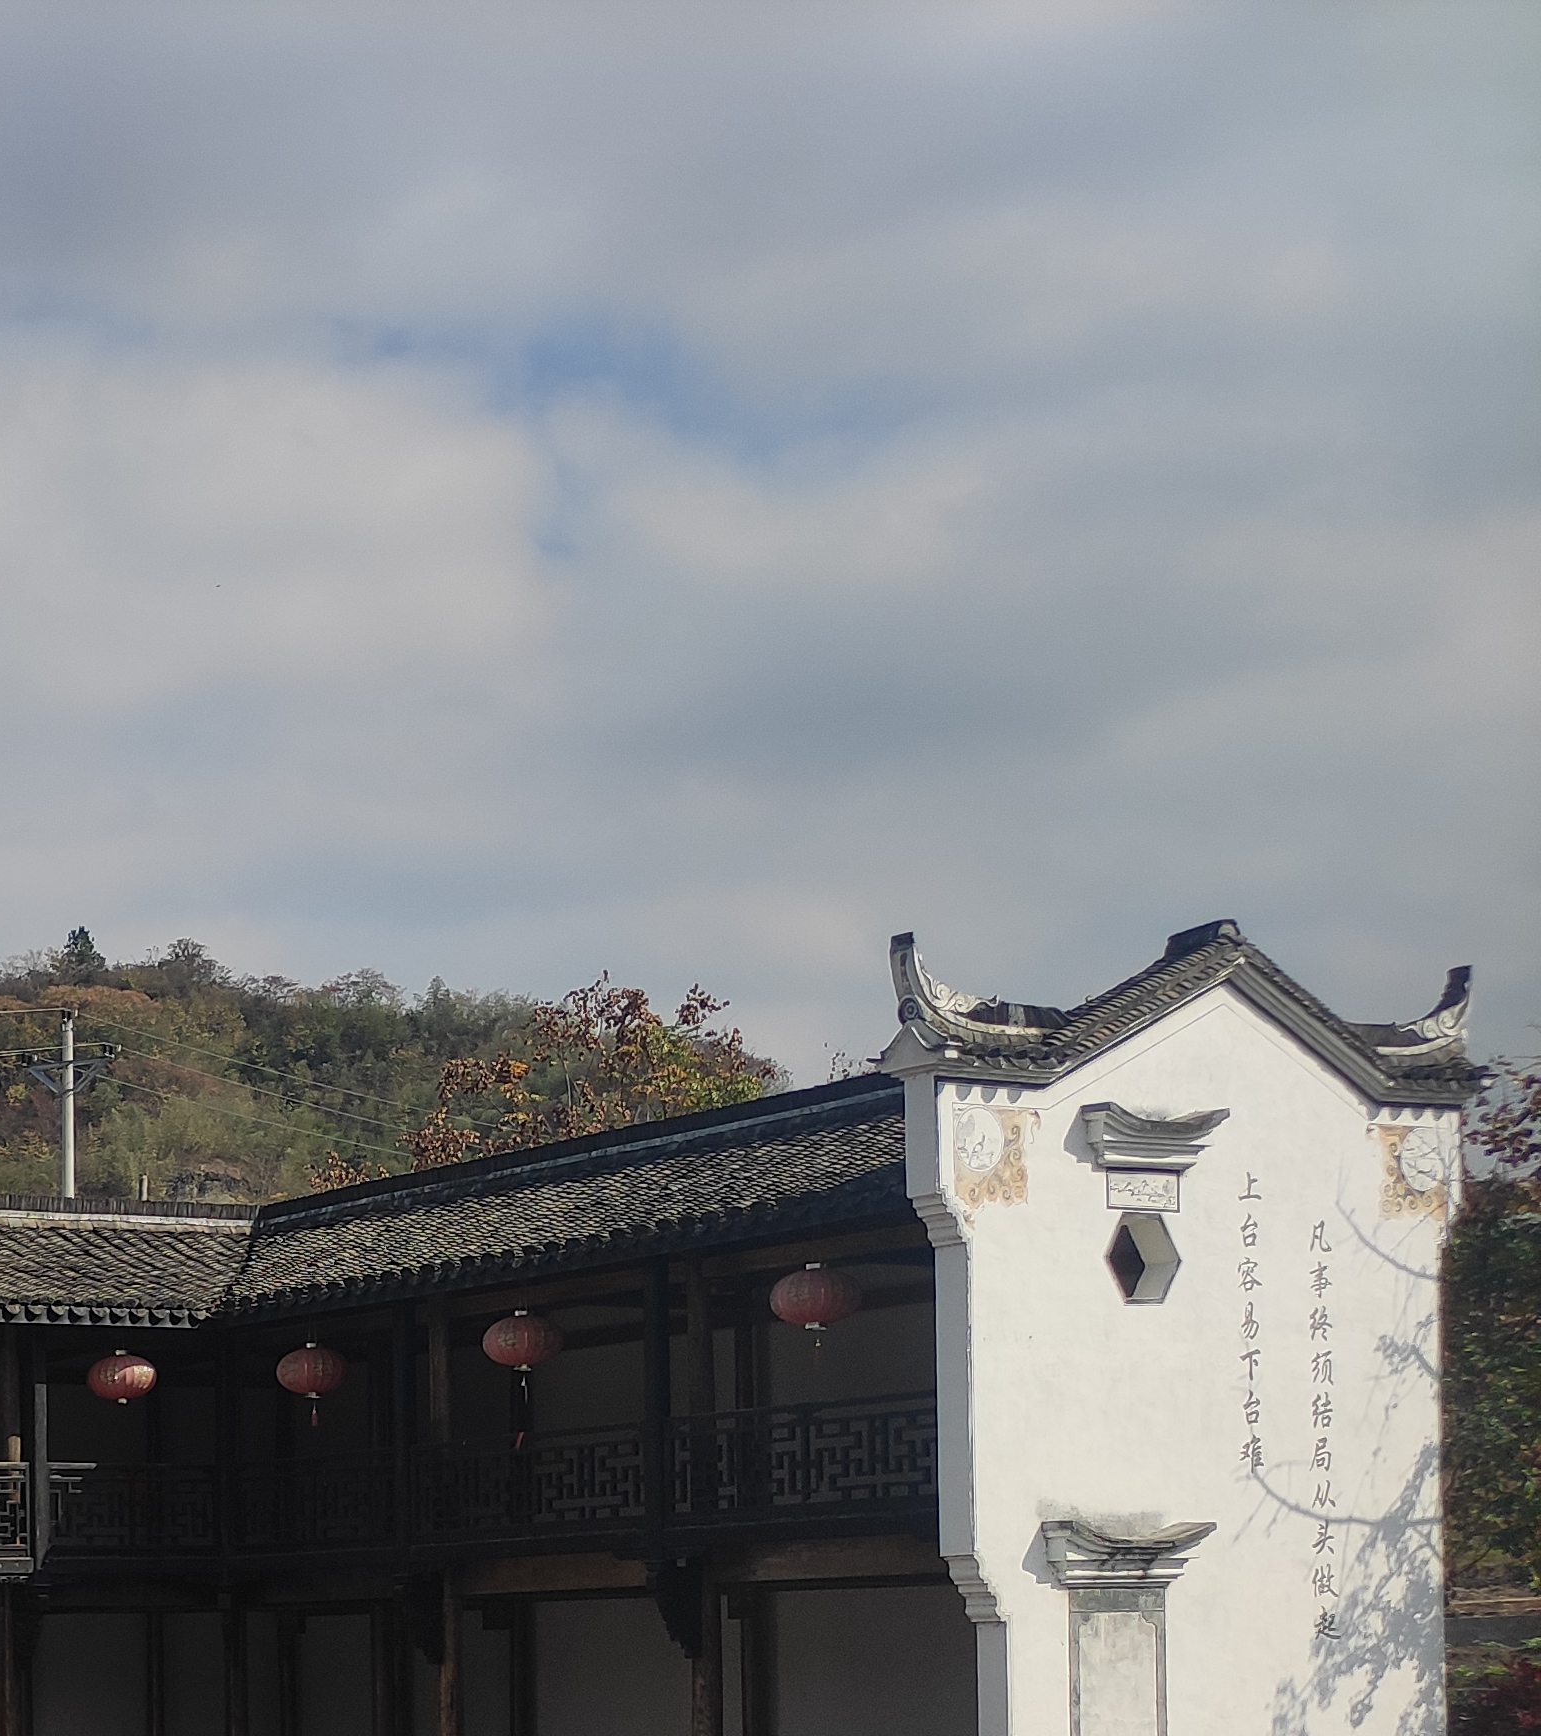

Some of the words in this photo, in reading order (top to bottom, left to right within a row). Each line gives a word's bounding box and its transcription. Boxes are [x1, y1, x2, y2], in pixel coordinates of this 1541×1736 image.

[1237, 1171, 1265, 1474] 上台容易下台难
[1309, 1219, 1342, 1641] 凡事终须结局从头做起
